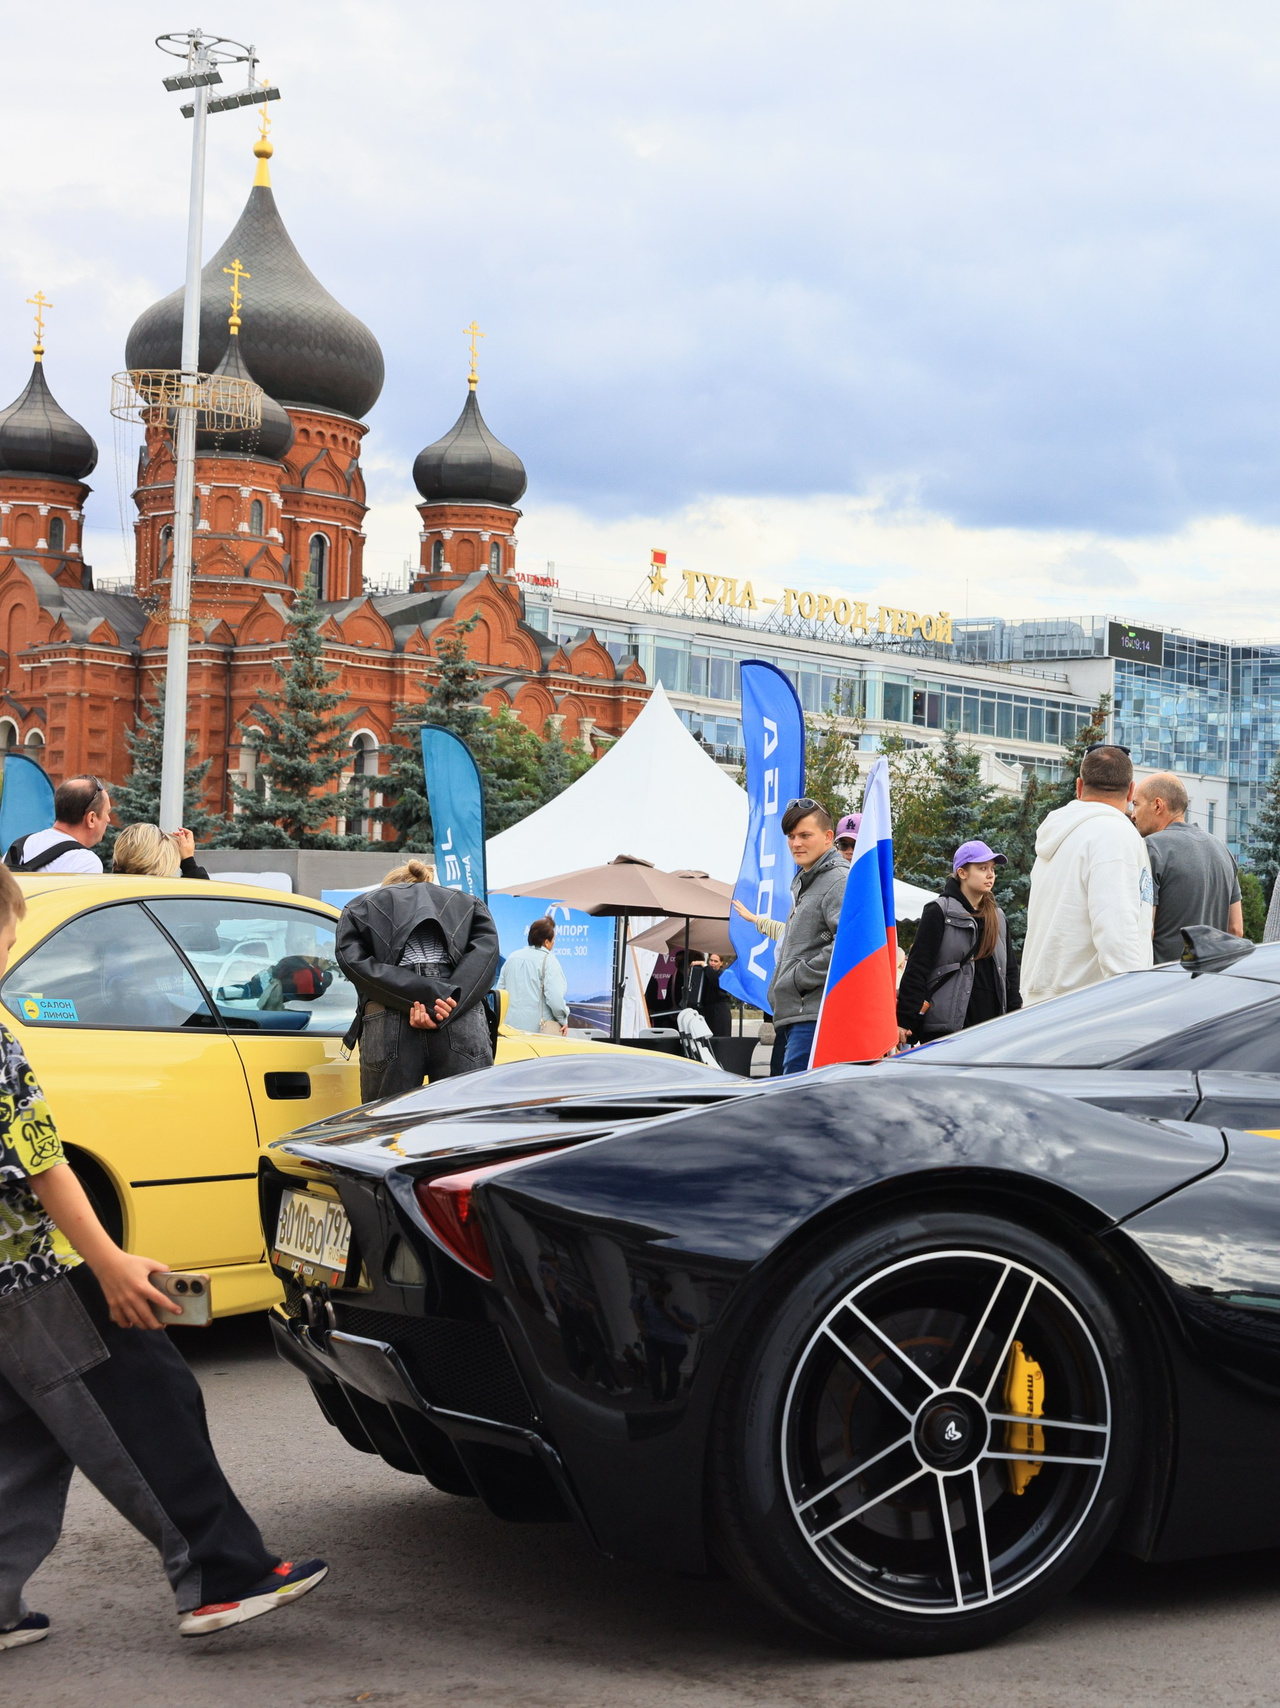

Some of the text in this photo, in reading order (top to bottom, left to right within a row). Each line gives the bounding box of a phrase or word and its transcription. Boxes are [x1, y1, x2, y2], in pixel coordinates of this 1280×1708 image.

[682, 569, 757, 610] ТУЛА
[40, 1001, 72, 1009] САЛОН
[43, 1011, 76, 1019] ЛИМОН
